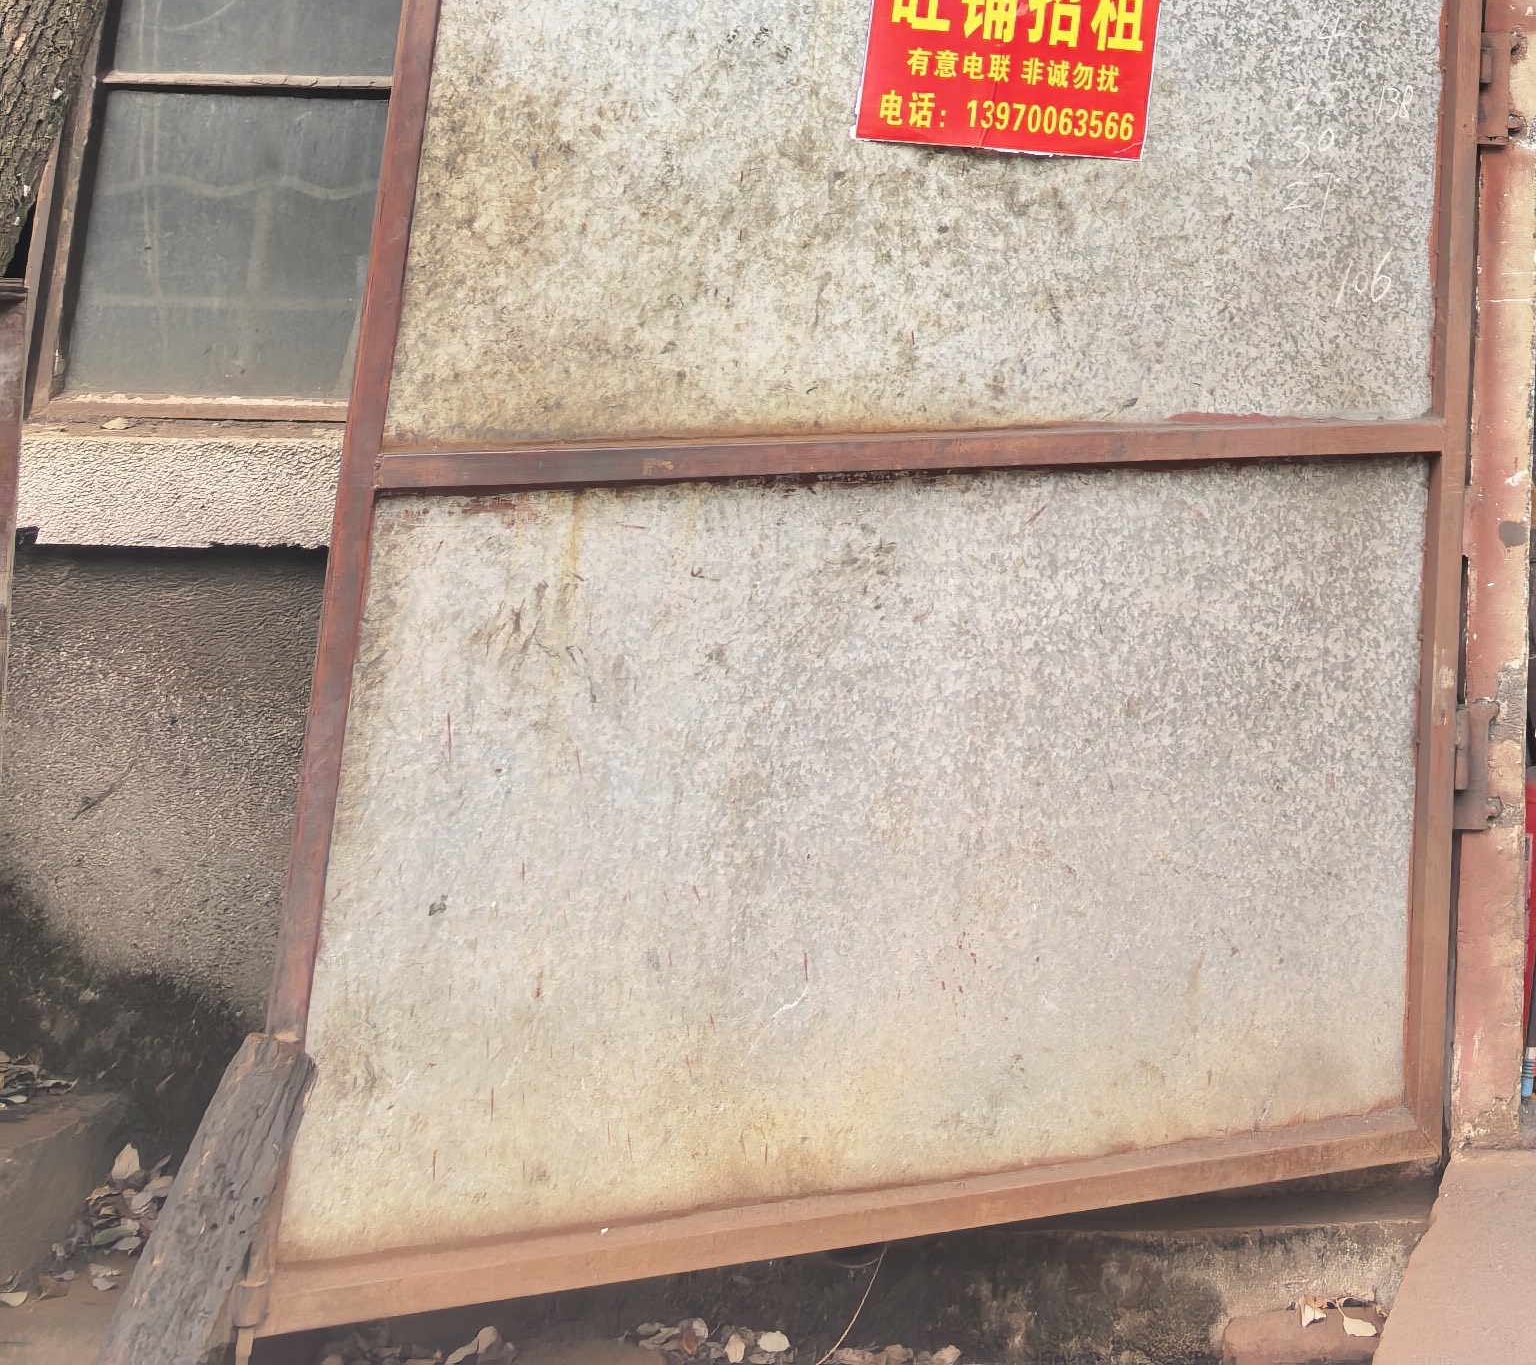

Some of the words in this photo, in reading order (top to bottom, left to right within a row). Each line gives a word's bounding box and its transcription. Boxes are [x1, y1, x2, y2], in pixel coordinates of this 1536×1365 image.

[907, 47, 1012, 83] 有意电联
[1021, 58, 1120, 93] 非诚勿扰
[966, 99, 1135, 141] 13970063566
